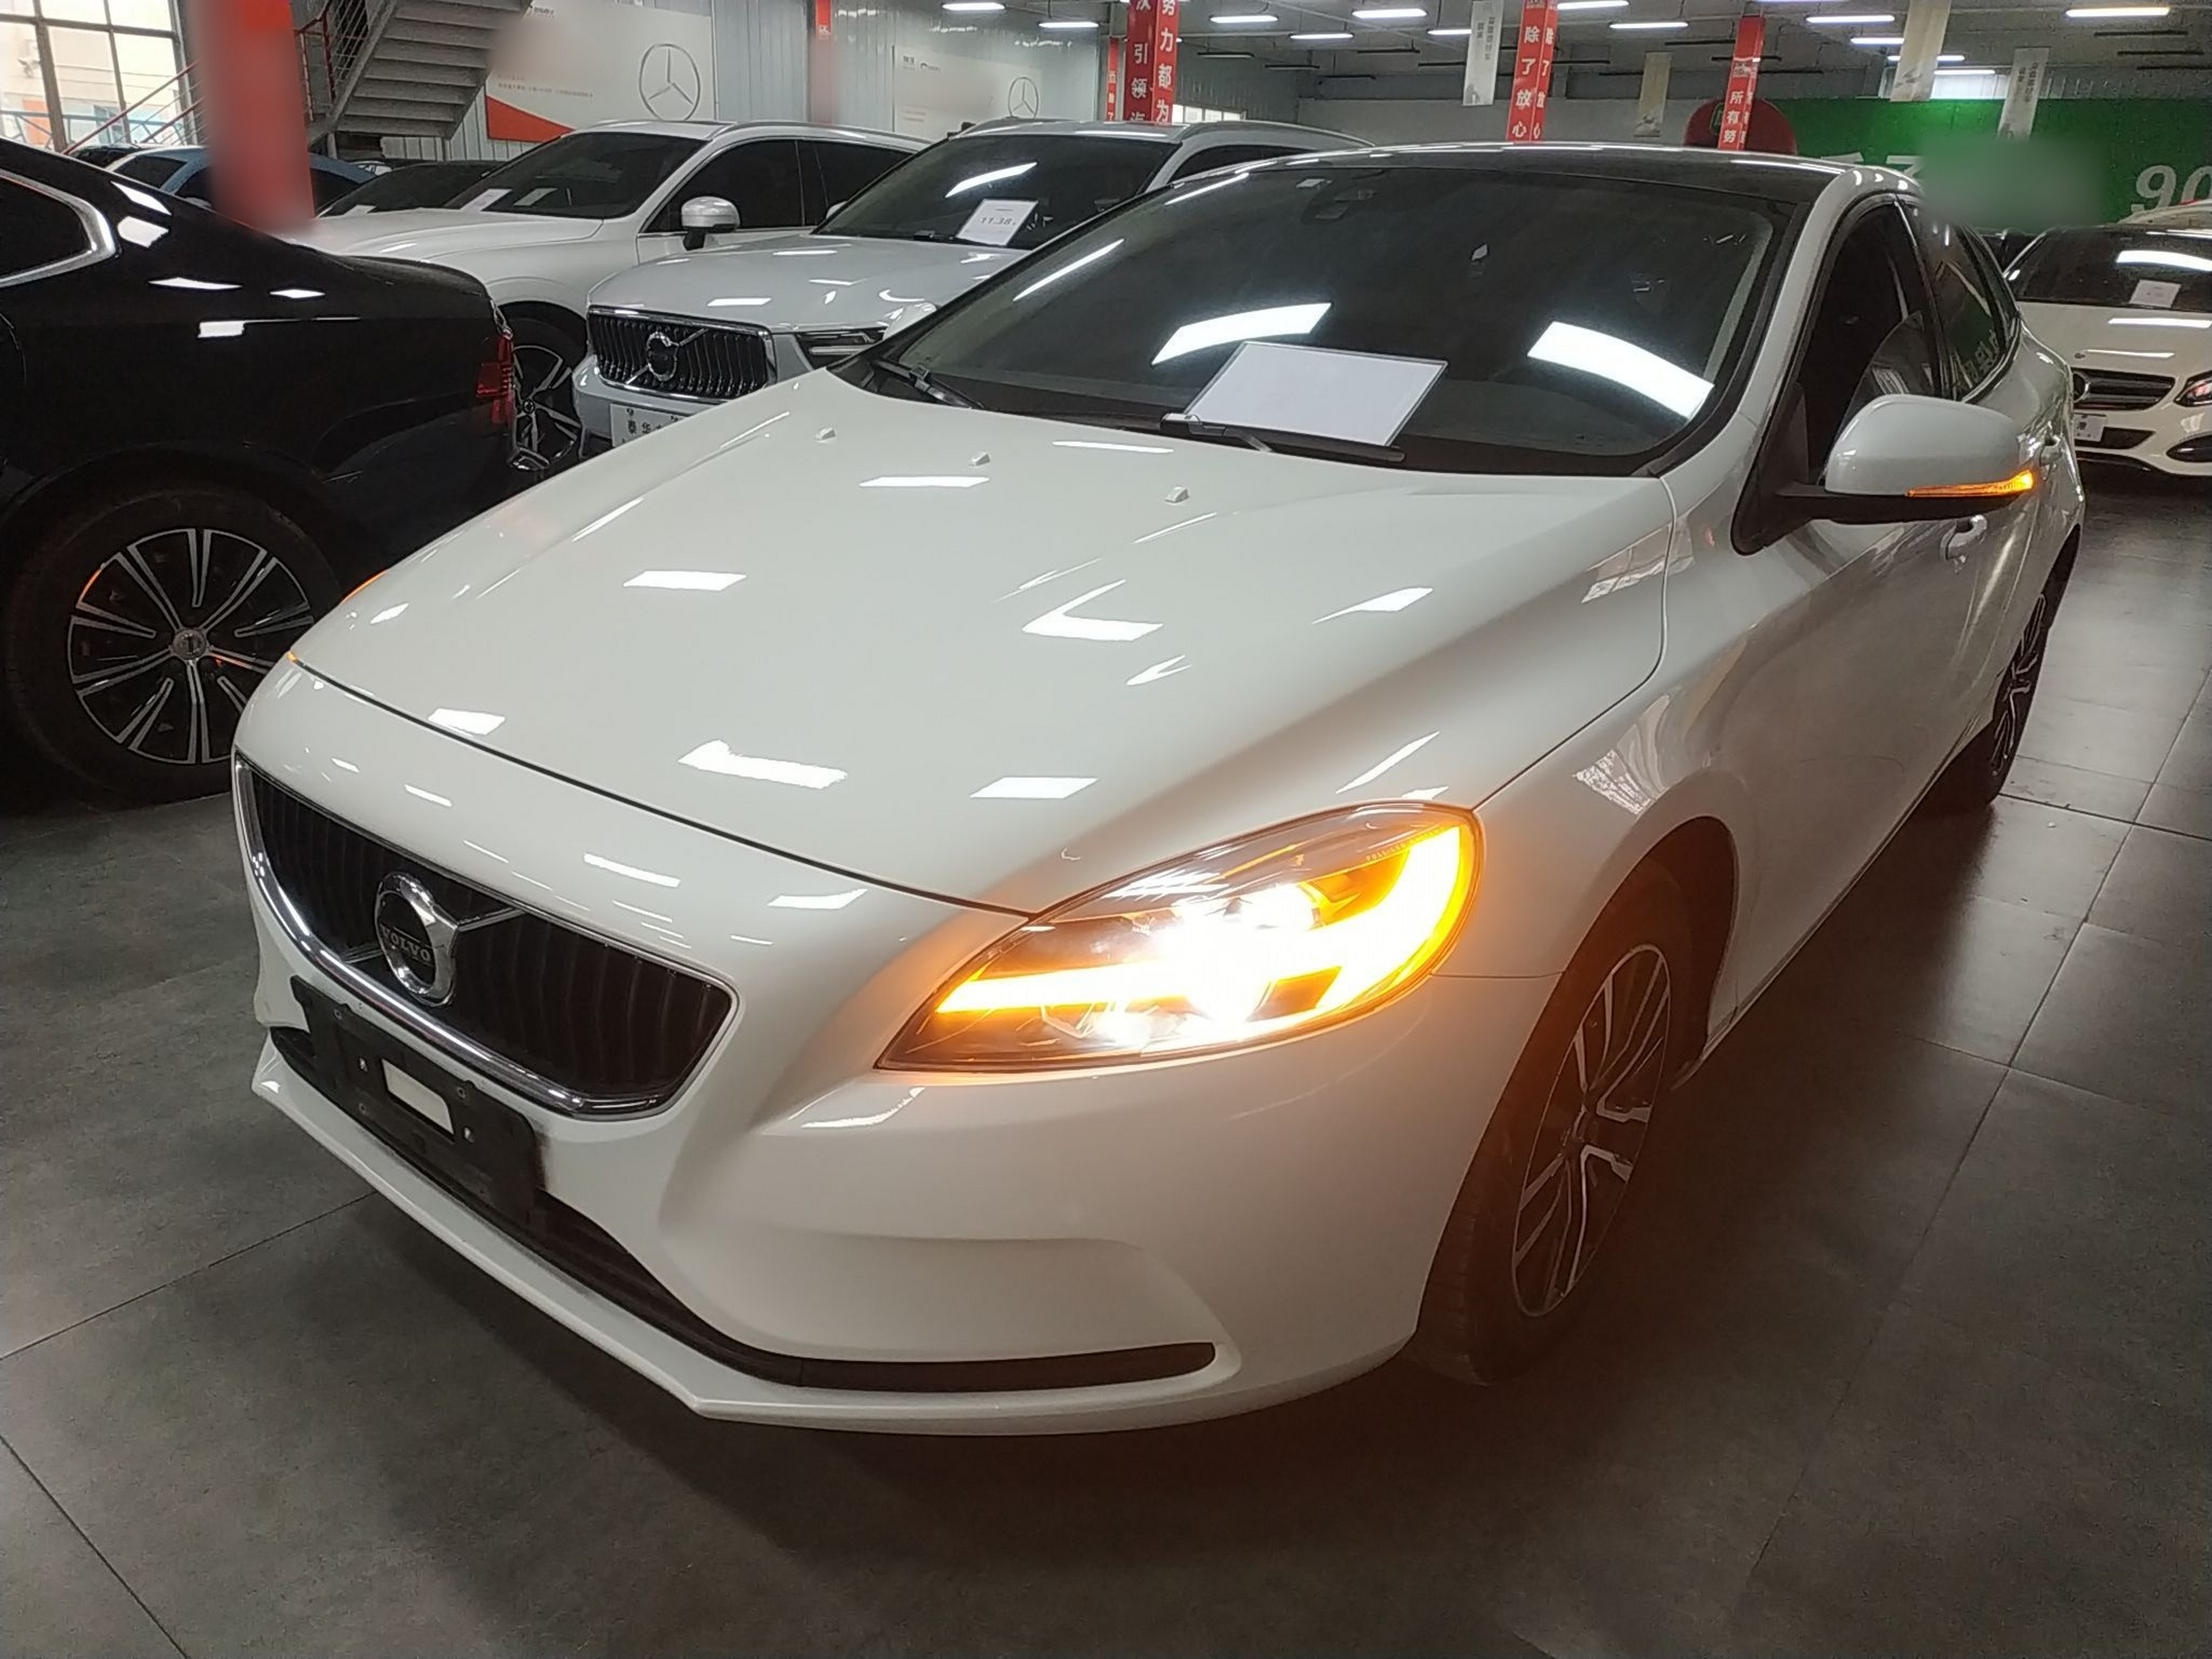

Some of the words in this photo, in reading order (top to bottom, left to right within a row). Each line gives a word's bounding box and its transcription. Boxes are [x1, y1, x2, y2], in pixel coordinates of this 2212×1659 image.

[1512, 25, 1540, 138] 除了放心
[380, 923, 430, 961] VOLVO
